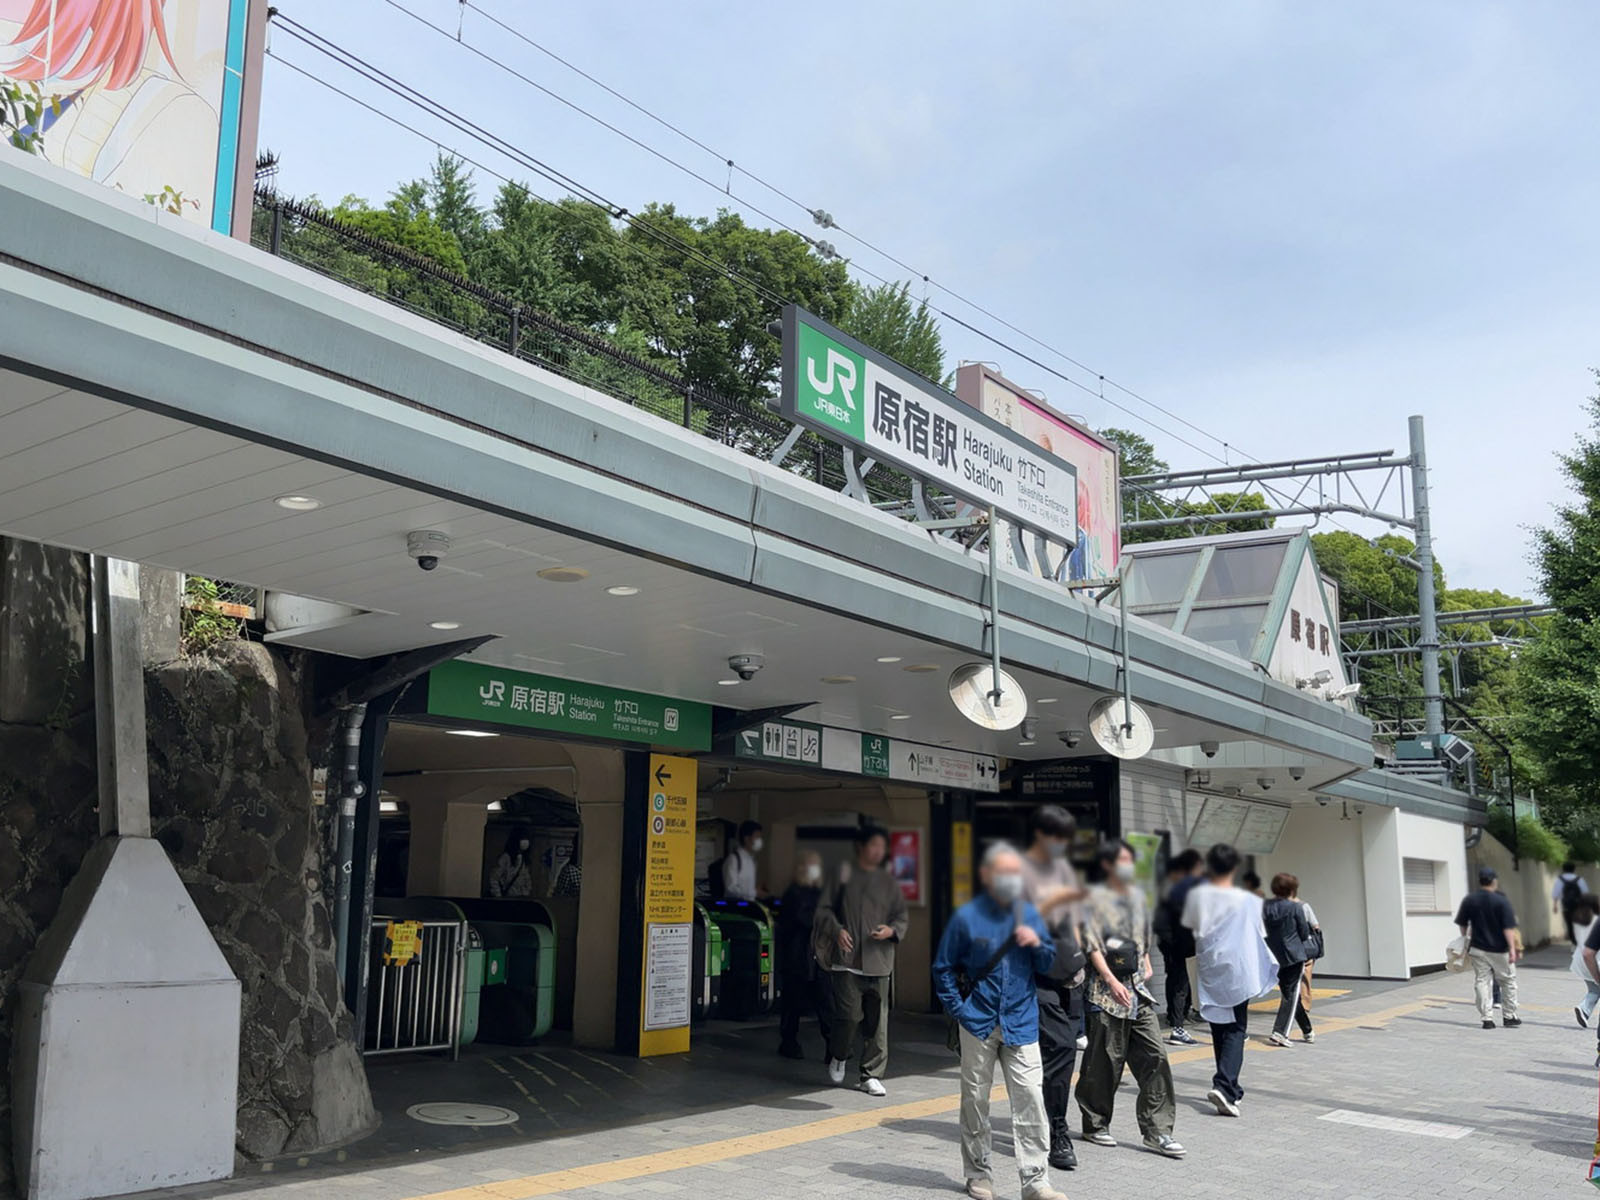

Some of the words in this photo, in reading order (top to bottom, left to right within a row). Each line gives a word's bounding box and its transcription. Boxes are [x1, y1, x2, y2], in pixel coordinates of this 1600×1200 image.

[808, 347, 856, 410] JR
[814, 397, 851, 424] JR東日本
[872, 381, 958, 473] 原宿駅
[963, 427, 1013, 473] Harajuku
[963, 458, 1004, 496] Station
[1017, 456, 1046, 489] 竹下口
[1017, 481, 1044, 505] Takeshita
[1044, 495, 1070, 517] Entrance
[1291, 609, 1329, 655] 原宿駅
[480, 680, 505, 701] JR
[510, 685, 565, 716] 原宿駅
[569, 694, 605, 710] Harajuku
[614, 699, 639, 714] 竹下口
[569, 706, 597, 721] Station
[870, 739, 882, 751] JR
